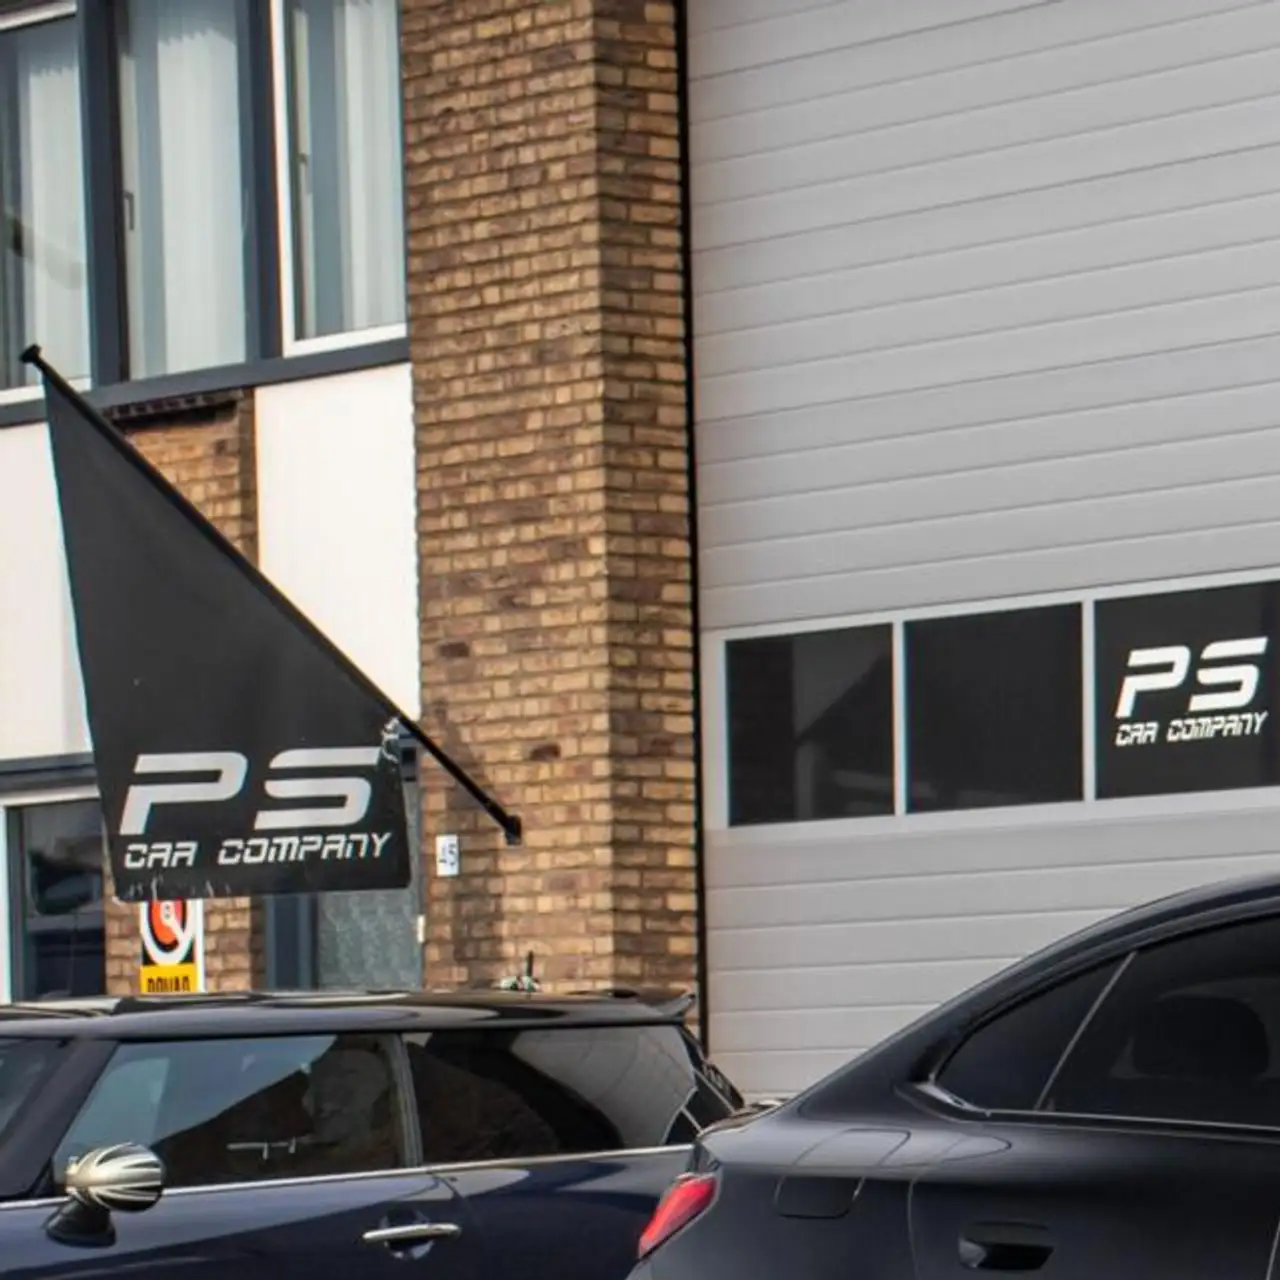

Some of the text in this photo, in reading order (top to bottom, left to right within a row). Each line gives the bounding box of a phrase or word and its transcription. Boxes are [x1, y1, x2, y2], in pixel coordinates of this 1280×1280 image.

[1115, 636, 1268, 719] PS
[1115, 711, 1268, 747] CAR COMPANY
[119, 747, 380, 836] PS
[124, 832, 391, 869] CAR COMPANY
